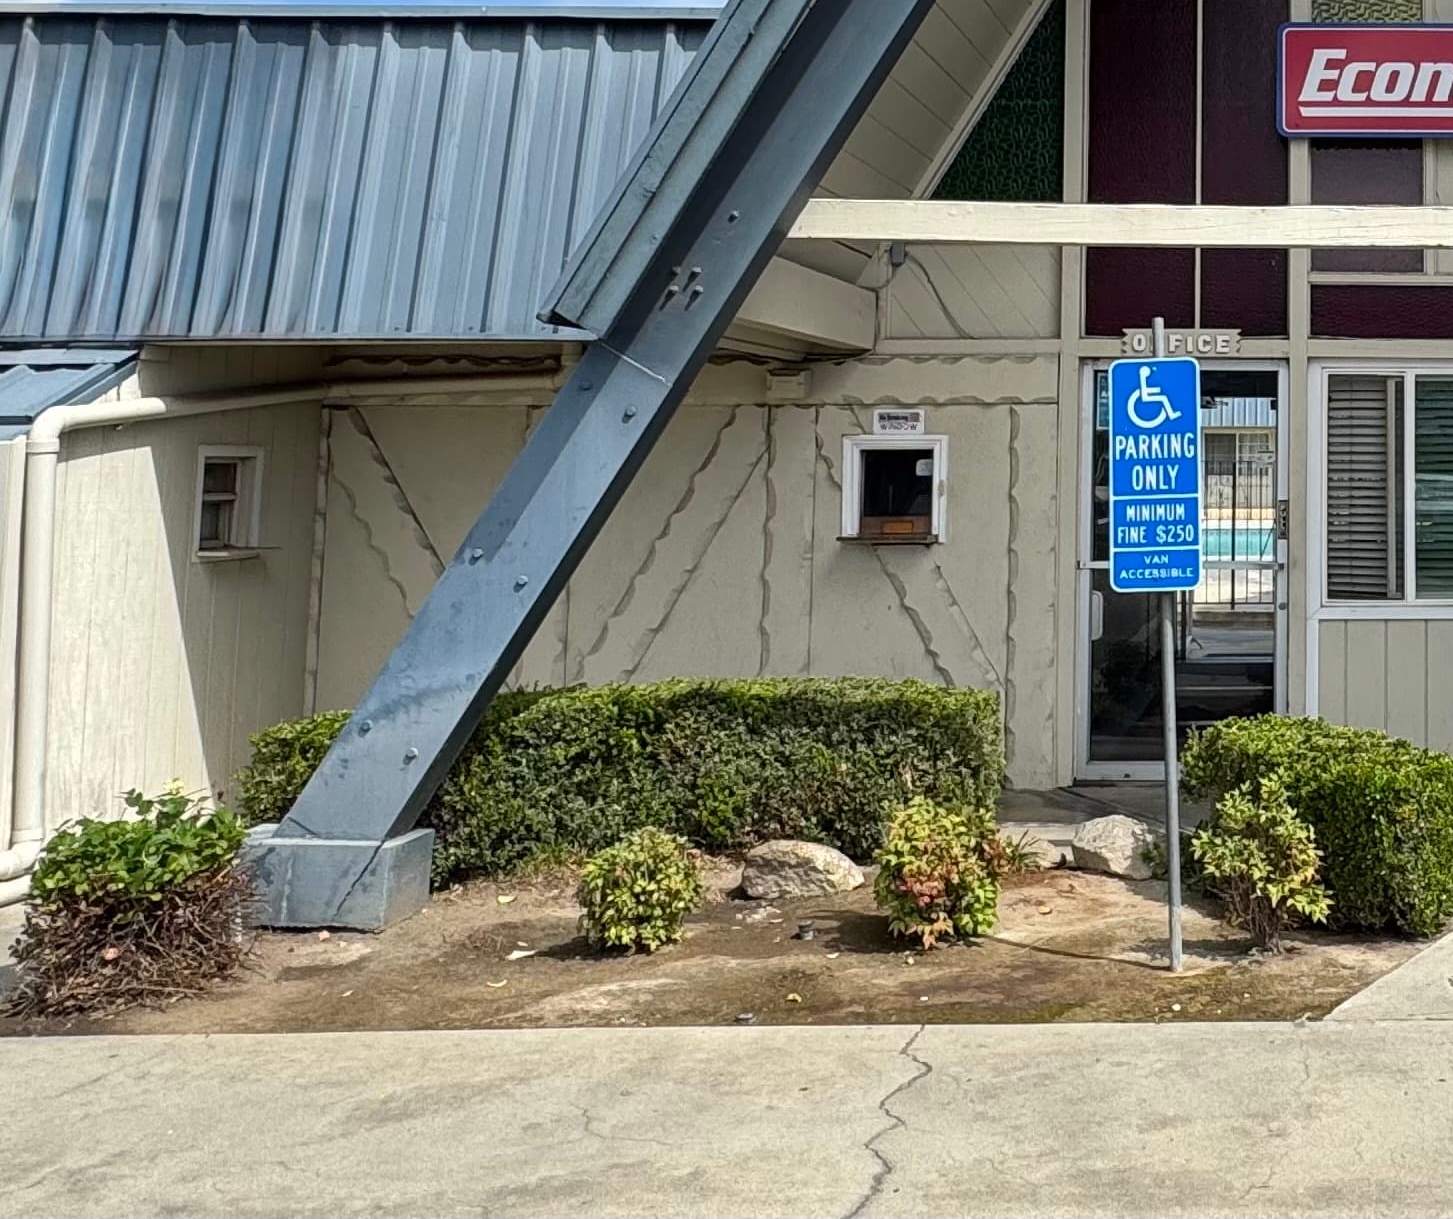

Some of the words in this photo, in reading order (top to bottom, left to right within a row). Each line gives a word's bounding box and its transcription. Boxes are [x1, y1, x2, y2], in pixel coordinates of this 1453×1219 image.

[1131, 333, 1231, 354] OFICE
[1115, 432, 1195, 461] PARKING
[1132, 463, 1180, 491] ONLY
[1126, 503, 1186, 523] MINIMUM
[1117, 526, 1148, 544] FINE
[1155, 524, 1195, 545] $250
[1143, 554, 1169, 565] VAN
[1119, 567, 1195, 579] ACCESSIBLE
